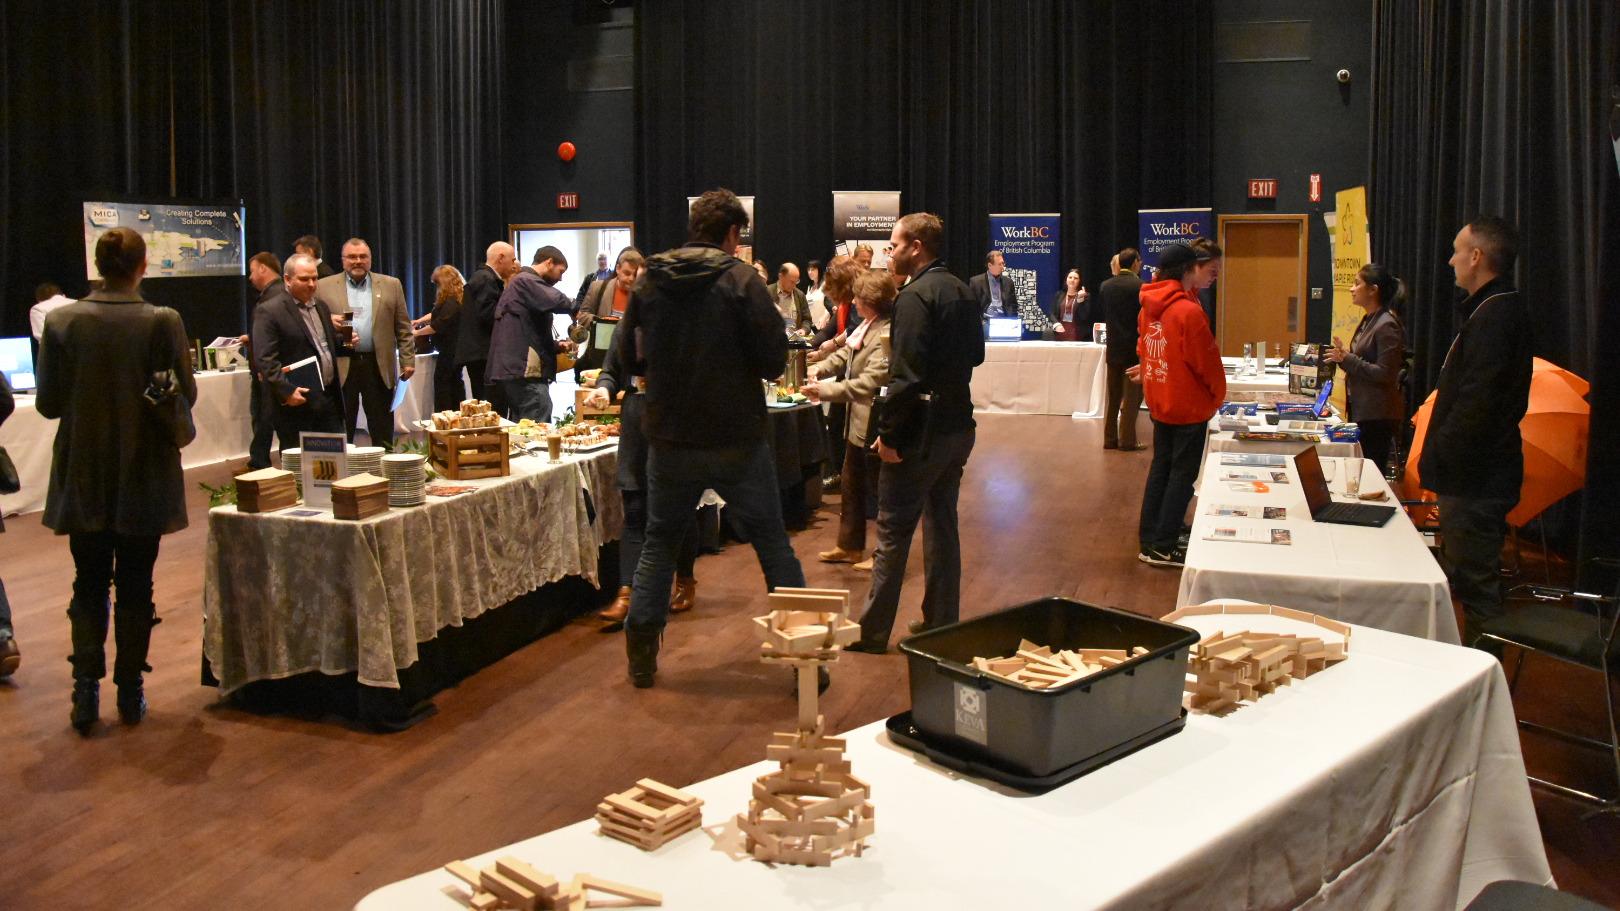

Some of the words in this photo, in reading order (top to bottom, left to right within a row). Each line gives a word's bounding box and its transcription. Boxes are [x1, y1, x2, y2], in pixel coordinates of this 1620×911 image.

[1252, 181, 1274, 197] EXIT
[560, 194, 577, 208] EXIT
[94, 210, 117, 218] MICA
[166, 209, 193, 218] Creating
[194, 209, 227, 218] Complete
[182, 218, 213, 226] Solutions
[1001, 226, 1049, 238] WorkBC
[1150, 222, 1200, 236] WorkBC
[994, 239, 1030, 247] Employment
[1031, 239, 1055, 247] Program
[1143, 237, 1180, 246] Employment
